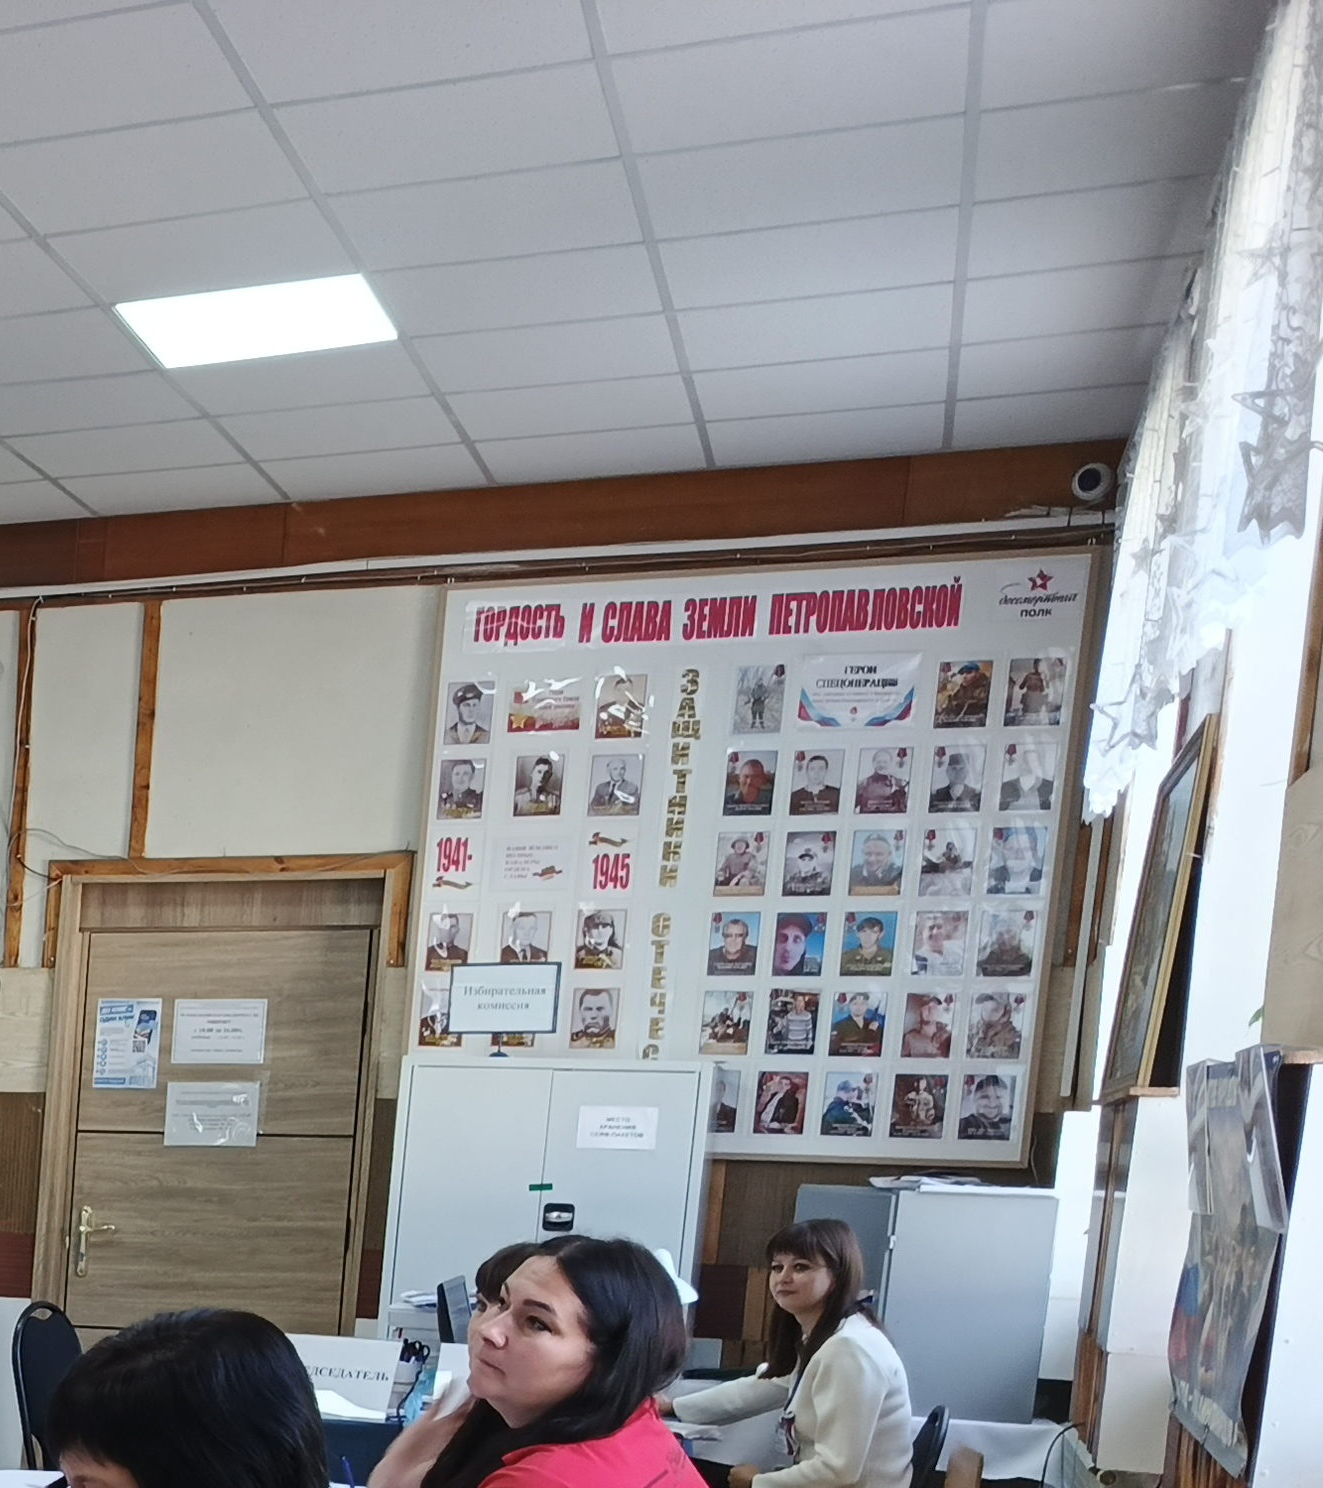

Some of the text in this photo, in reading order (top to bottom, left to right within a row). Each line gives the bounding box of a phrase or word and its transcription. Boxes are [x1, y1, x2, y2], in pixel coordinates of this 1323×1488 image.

[473, 576, 964, 646] ГОРДОСТЬ И СЛАВА ЗЕМЛИ ПЕТРОПАВЛОВСКОЙ
[592, 853, 631, 891] 1945
[463, 985, 546, 998] Избирательная
[477, 1002, 530, 1010] комиссия
